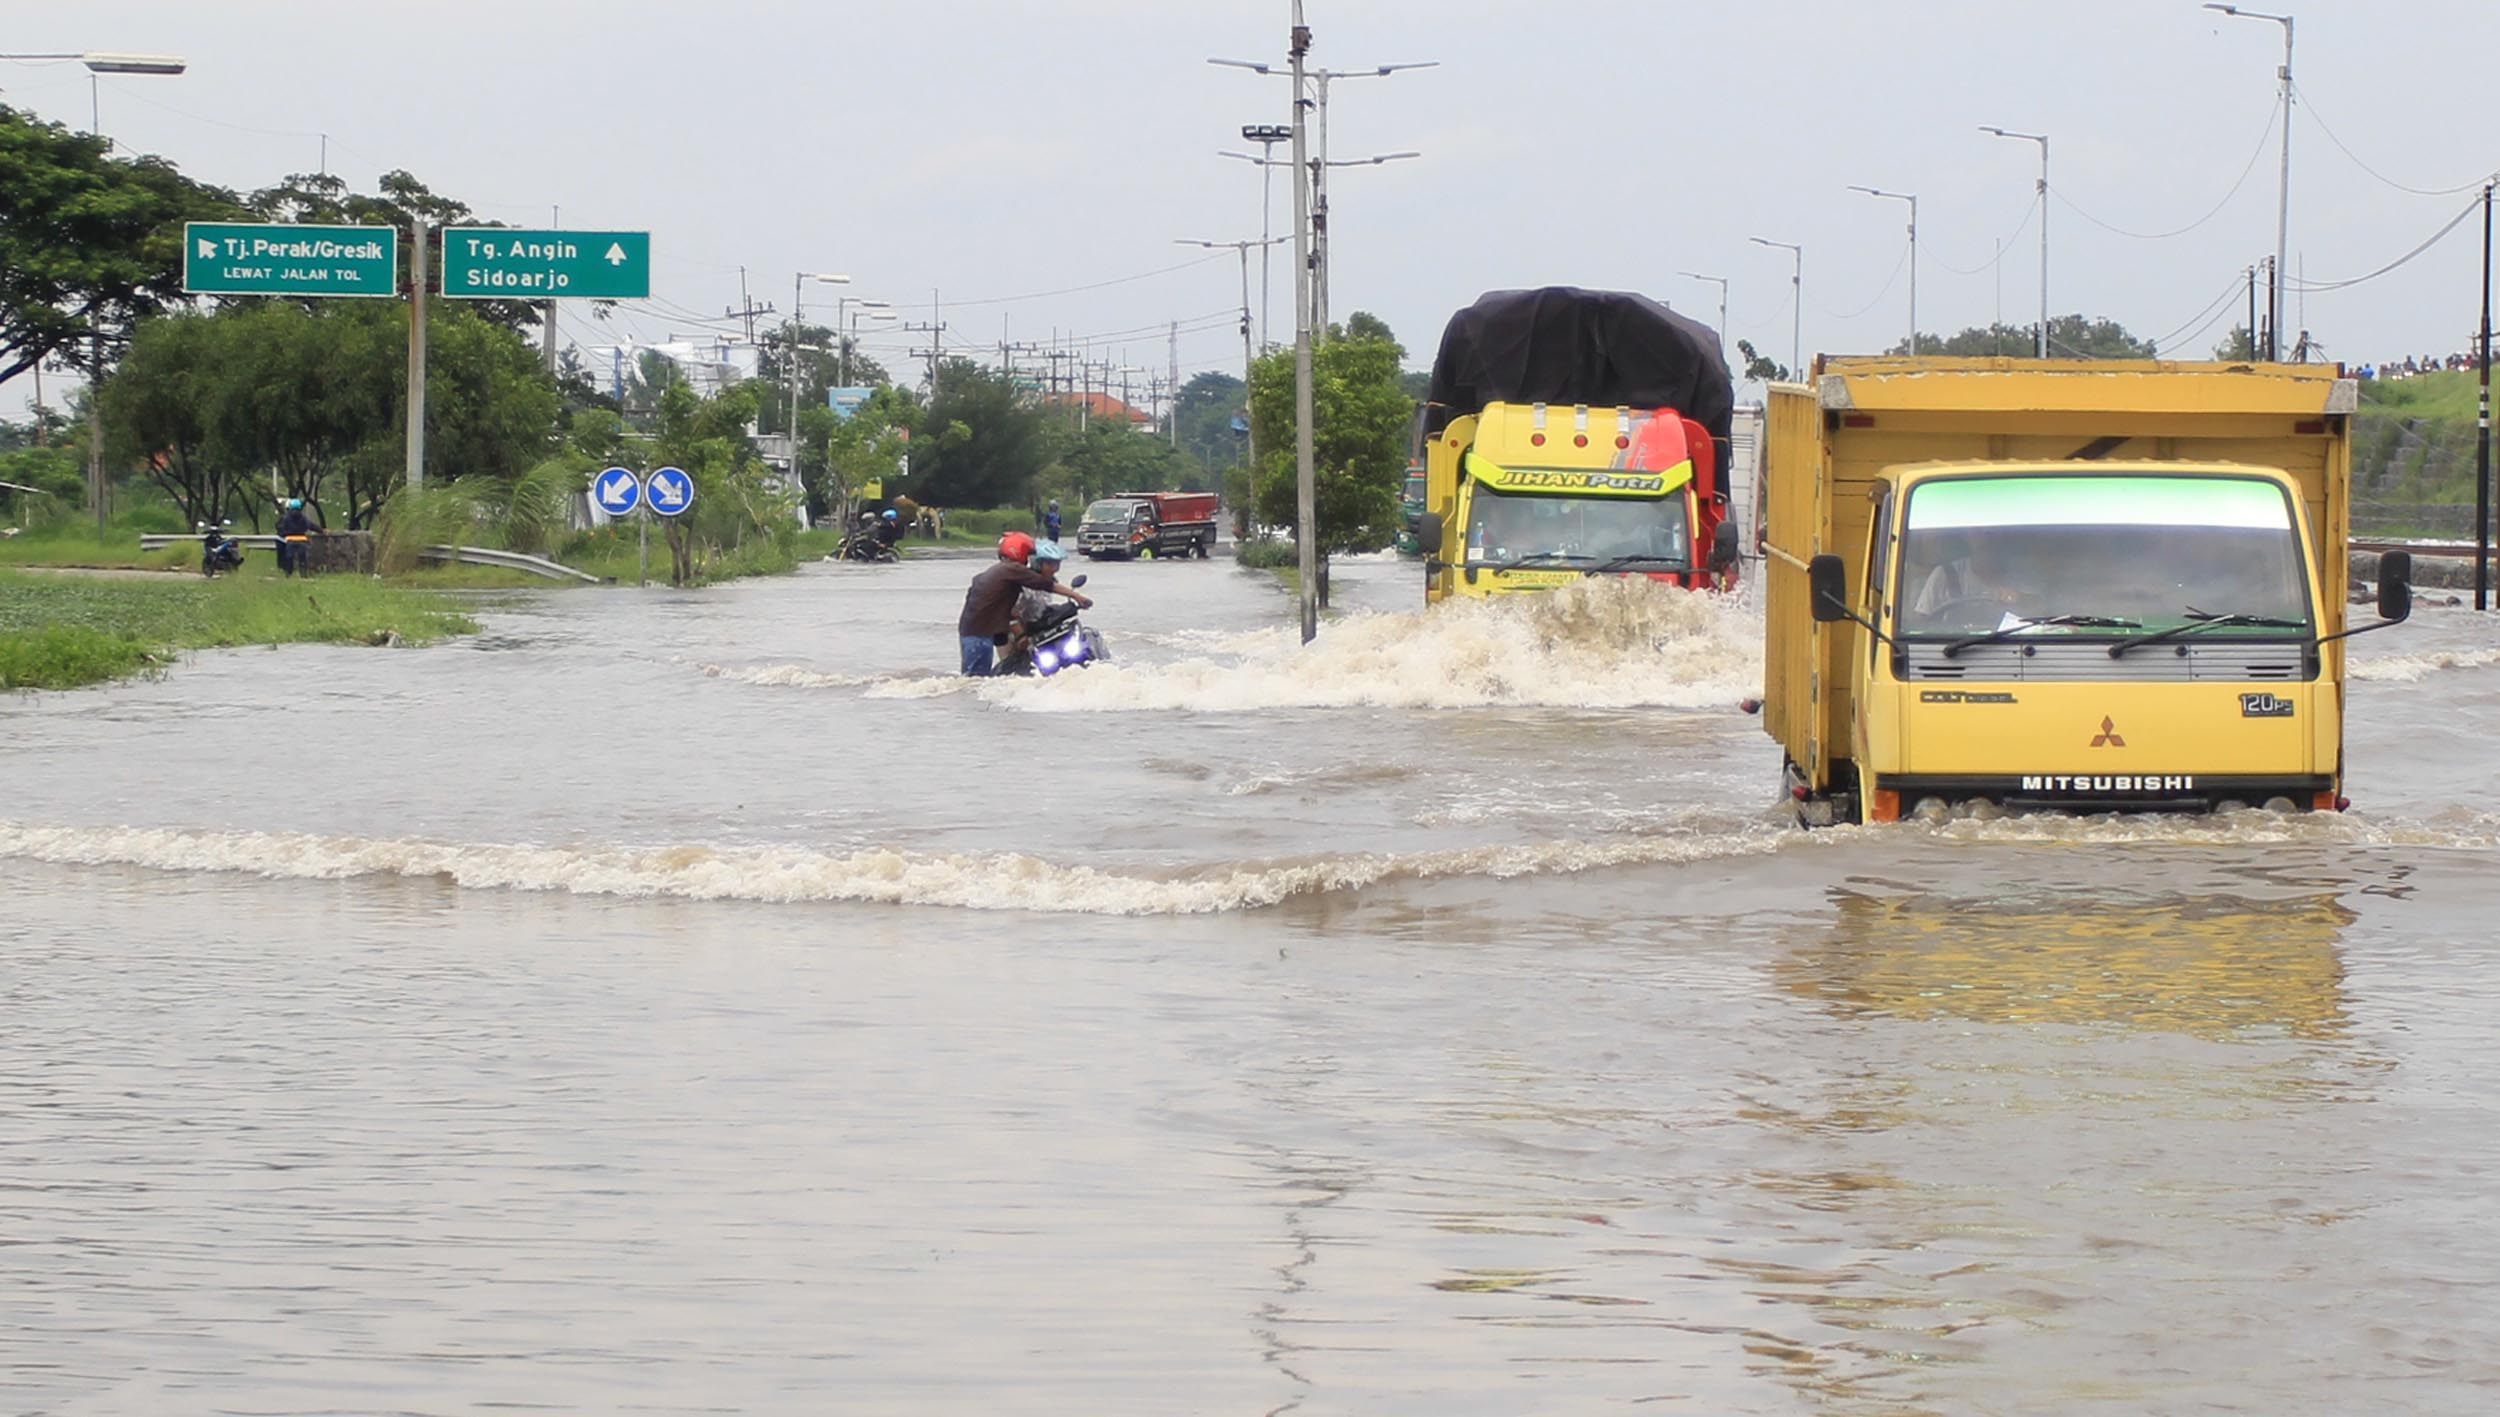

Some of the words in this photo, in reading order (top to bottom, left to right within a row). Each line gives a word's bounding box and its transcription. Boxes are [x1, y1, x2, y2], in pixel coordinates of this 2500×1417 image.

[224, 238, 250, 260] Tj.
[253, 239, 383, 260] Perak/Gresik
[467, 240, 502, 260] Tg.
[509, 240, 577, 261] Angin
[223, 267, 272, 279] LEWAT
[280, 269, 328, 280] JALAN
[335, 269, 361, 281] TOL
[467, 269, 569, 290] Sidoarjo
[1498, 472, 1586, 486] JIHAN
[2022, 775, 2193, 791] MITSUBISHI
